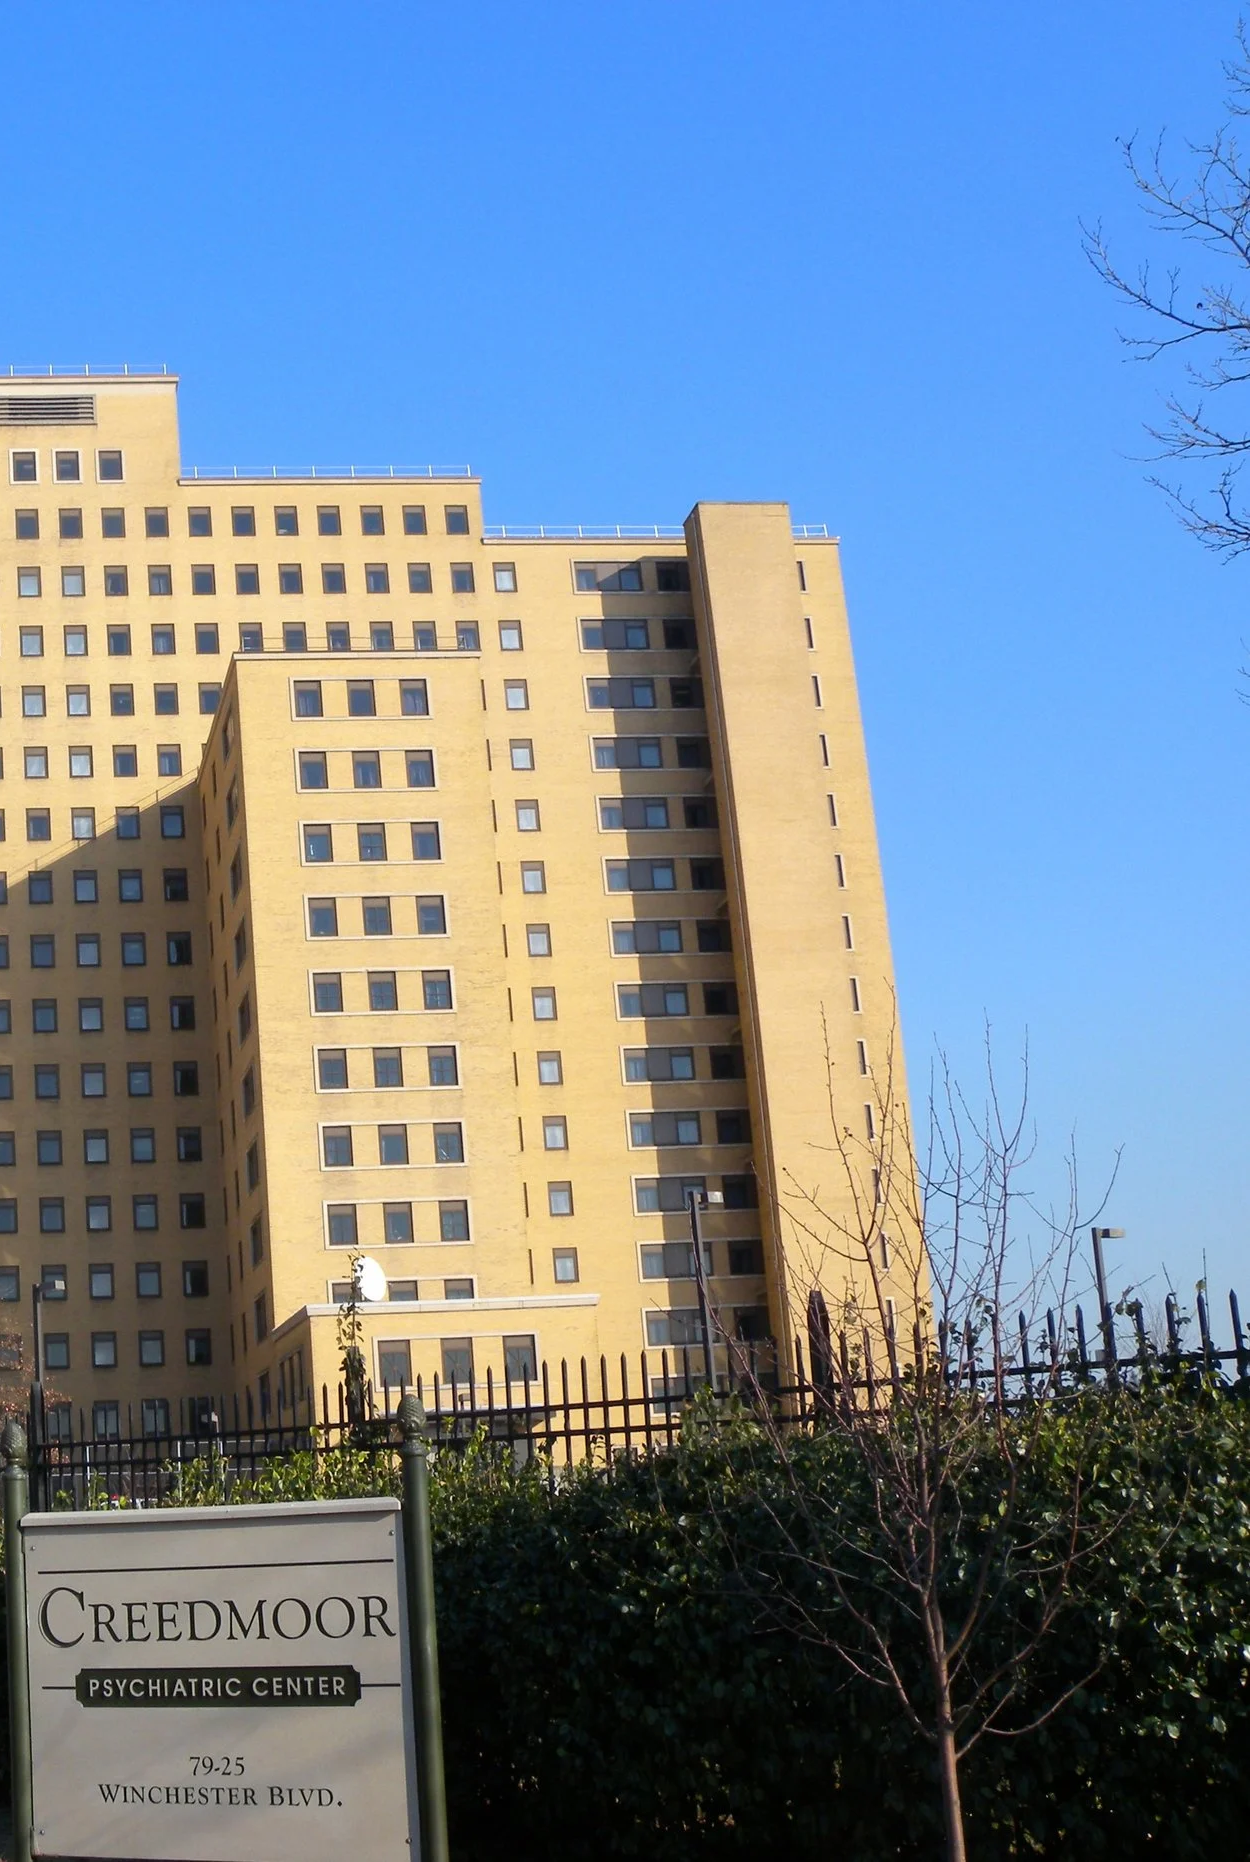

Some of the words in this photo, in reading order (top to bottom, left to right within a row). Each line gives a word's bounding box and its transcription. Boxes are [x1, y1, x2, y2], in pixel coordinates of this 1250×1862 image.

[38, 1586, 396, 1648] CREEDMOOR
[89, 1677, 241, 1697] PSYCHIATRIC
[252, 1676, 346, 1697] CENTER
[189, 1756, 245, 1777] 79-25
[97, 1783, 258, 1806] WINCHESTER
[268, 1785, 343, 1808] BLVD.
